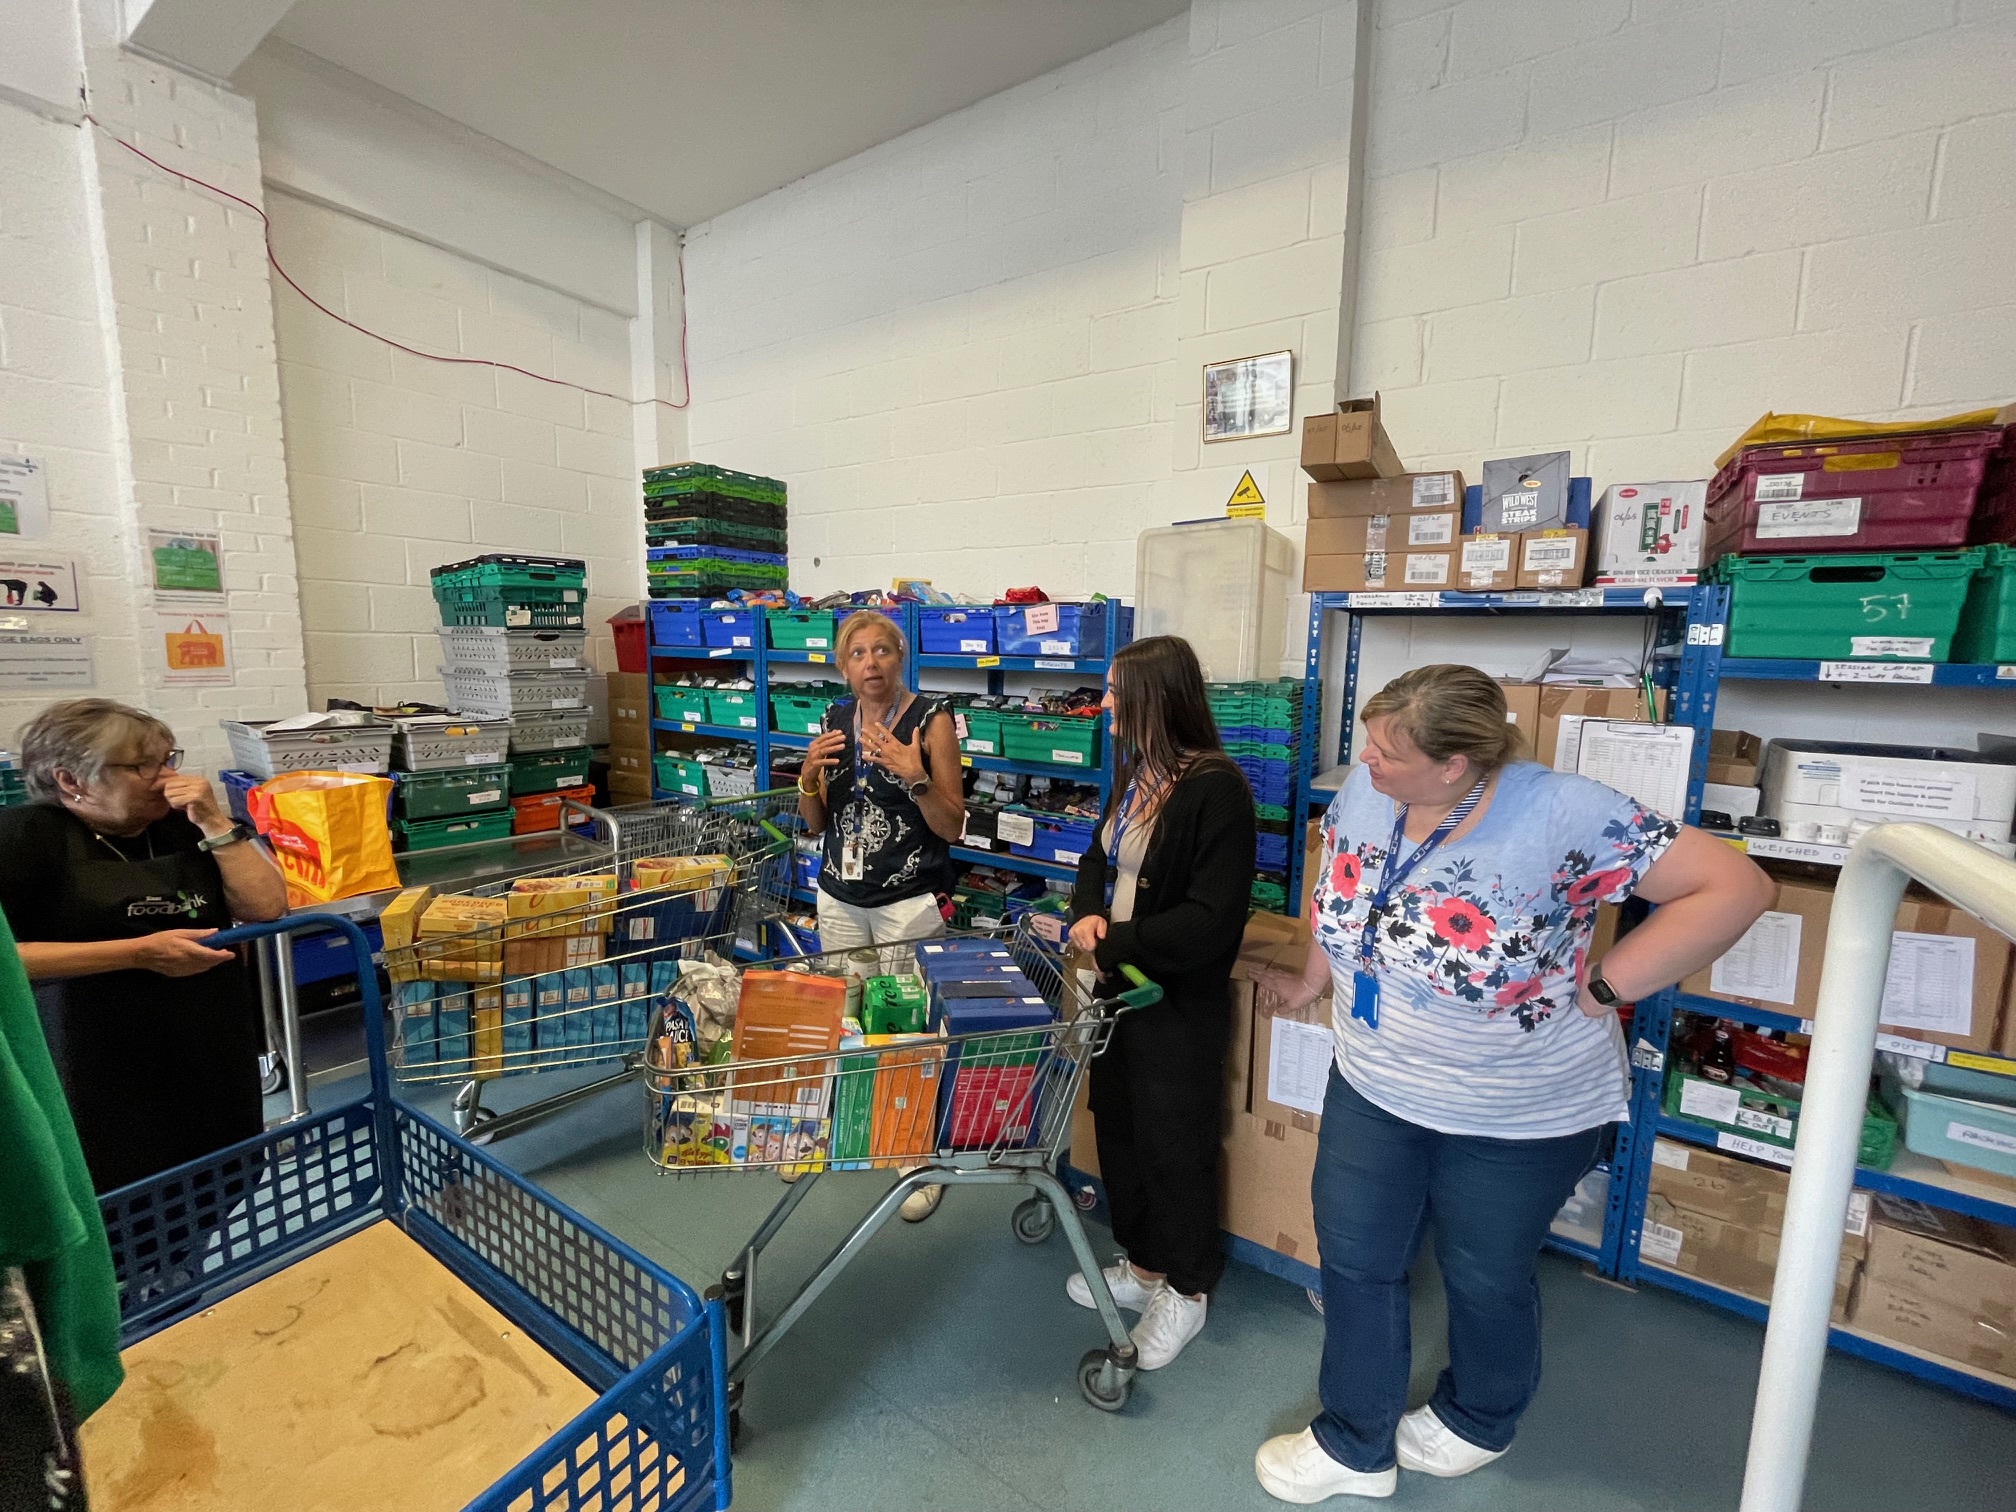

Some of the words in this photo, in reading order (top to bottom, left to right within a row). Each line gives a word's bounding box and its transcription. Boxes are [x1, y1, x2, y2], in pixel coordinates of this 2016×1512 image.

[1502, 495, 1519, 510] WILD
[1520, 493, 1538, 508] WEST
[1501, 516, 1537, 524] STRIPS
[1502, 509, 1538, 518] STEAK
[1772, 509, 1831, 521] EVENTS
[1860, 593, 1912, 622] 57
[1753, 842, 1819, 856] WEIGHED
[1731, 1138, 1765, 1154] HELP
